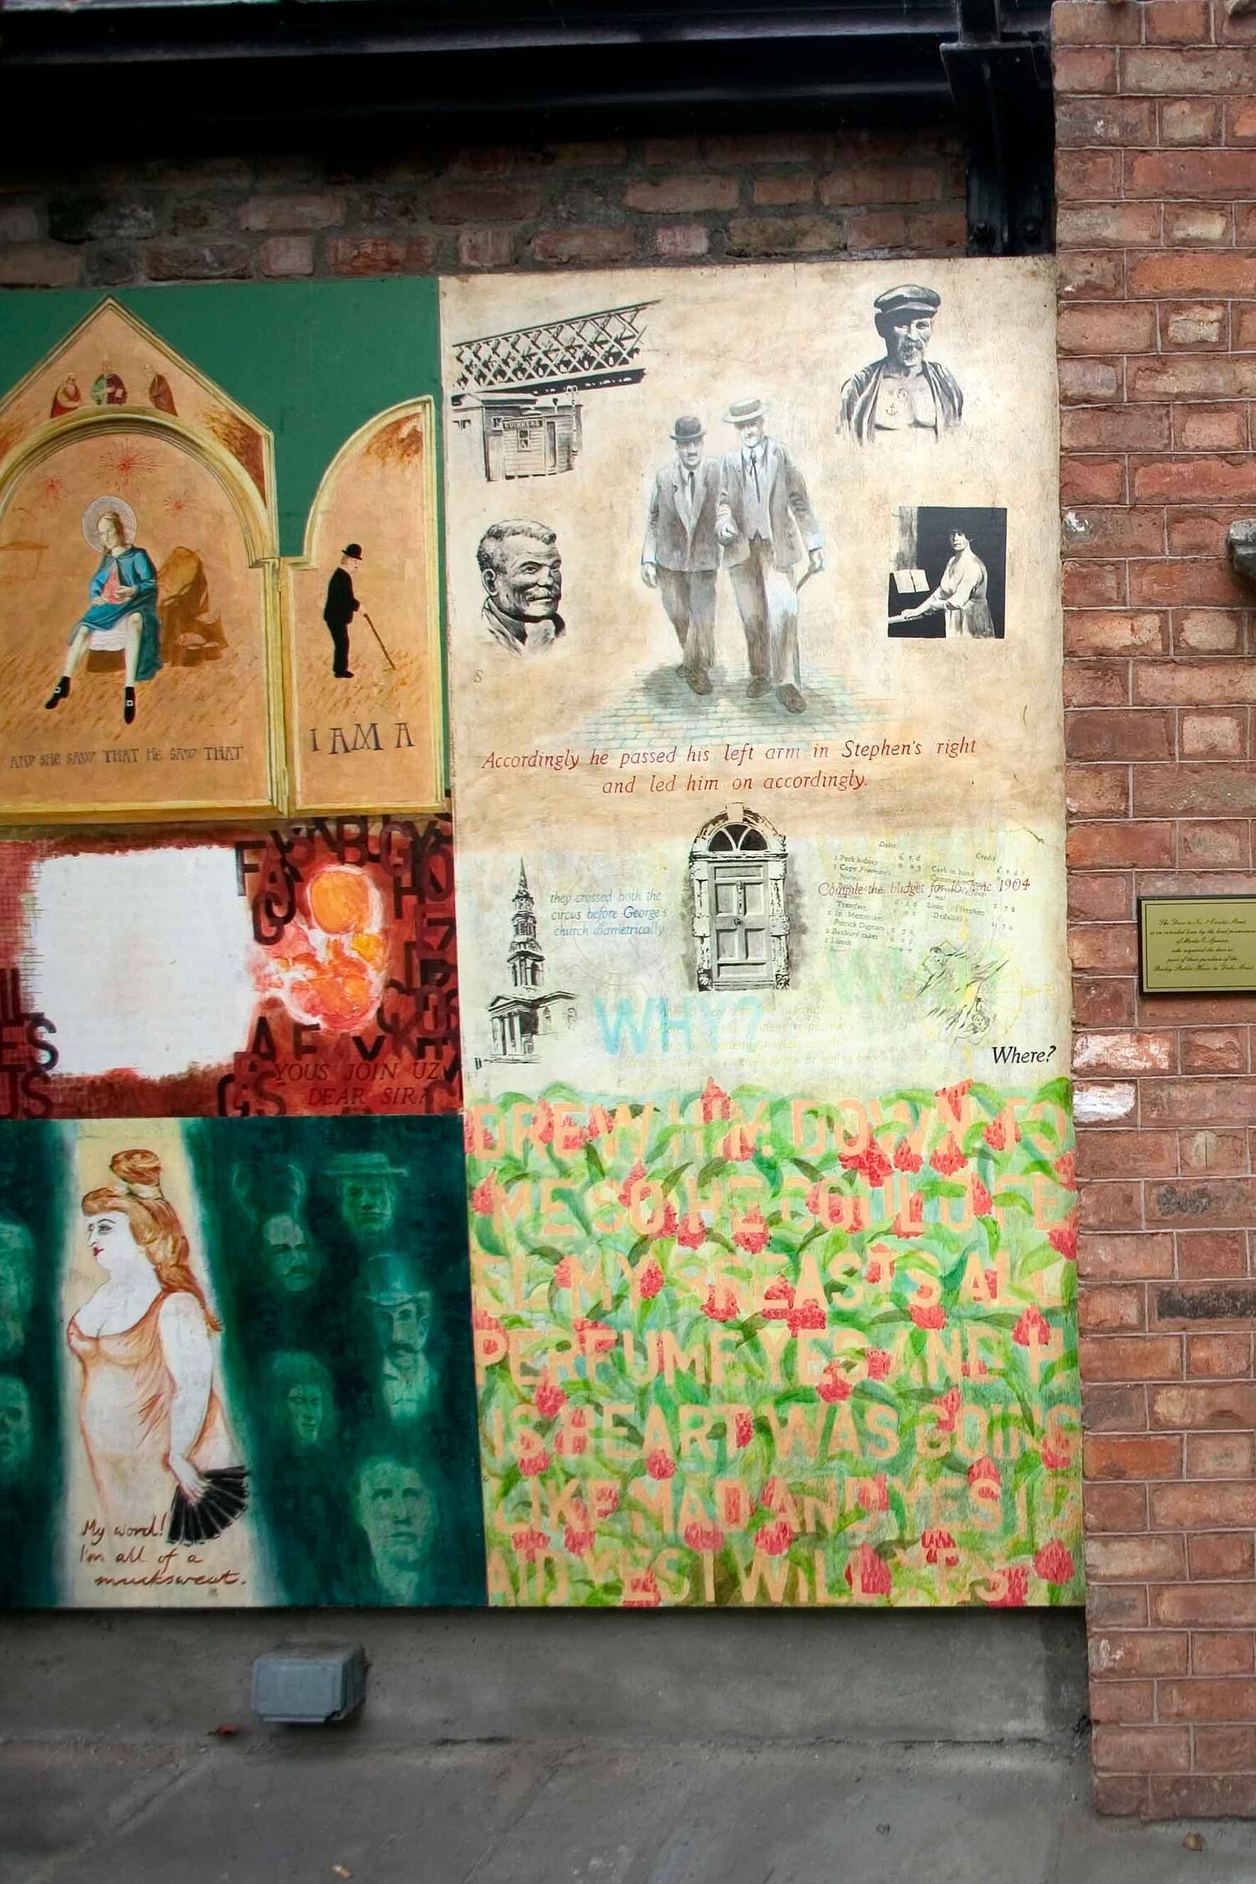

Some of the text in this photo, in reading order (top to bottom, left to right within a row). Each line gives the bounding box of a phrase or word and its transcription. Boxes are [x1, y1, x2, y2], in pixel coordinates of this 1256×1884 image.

[310, 722, 415, 755] I AM A
[103, 748, 139, 763] THAT
[170, 748, 197, 761] SAW
[204, 746, 244, 761] THAT
[481, 749, 580, 771] Accordingly
[590, 749, 609, 765] he
[620, 746, 677, 768] passed
[686, 745, 709, 762] his
[724, 743, 753, 766] left
[765, 748, 799, 760] arm
[813, 743, 828, 758] in
[841, 739, 922, 760] Stephen's
[937, 737, 976, 758] right
[602, 769, 867, 794] and led him on accordingly.
[235, 840, 266, 896] F
[550, 889, 661, 905] they crossed both the
[868, 881, 885, 896] the
[890, 880, 924, 897] budget
[927, 883, 945, 899] for
[998, 878, 1031, 894] 1904
[551, 910, 581, 920] circus
[587, 906, 618, 919] before
[554, 922, 665, 937] church diametrically
[991, 1044, 1057, 1063] Where?
[343, 1063, 398, 1081] JOIN
[308, 1086, 366, 1106] DEAR
[768, 1402, 901, 1460] WAS
[82, 1512, 168, 1546] My word!
[79, 1545, 203, 1573] I'm all of a
[94, 1569, 247, 1587] mucksweat.
